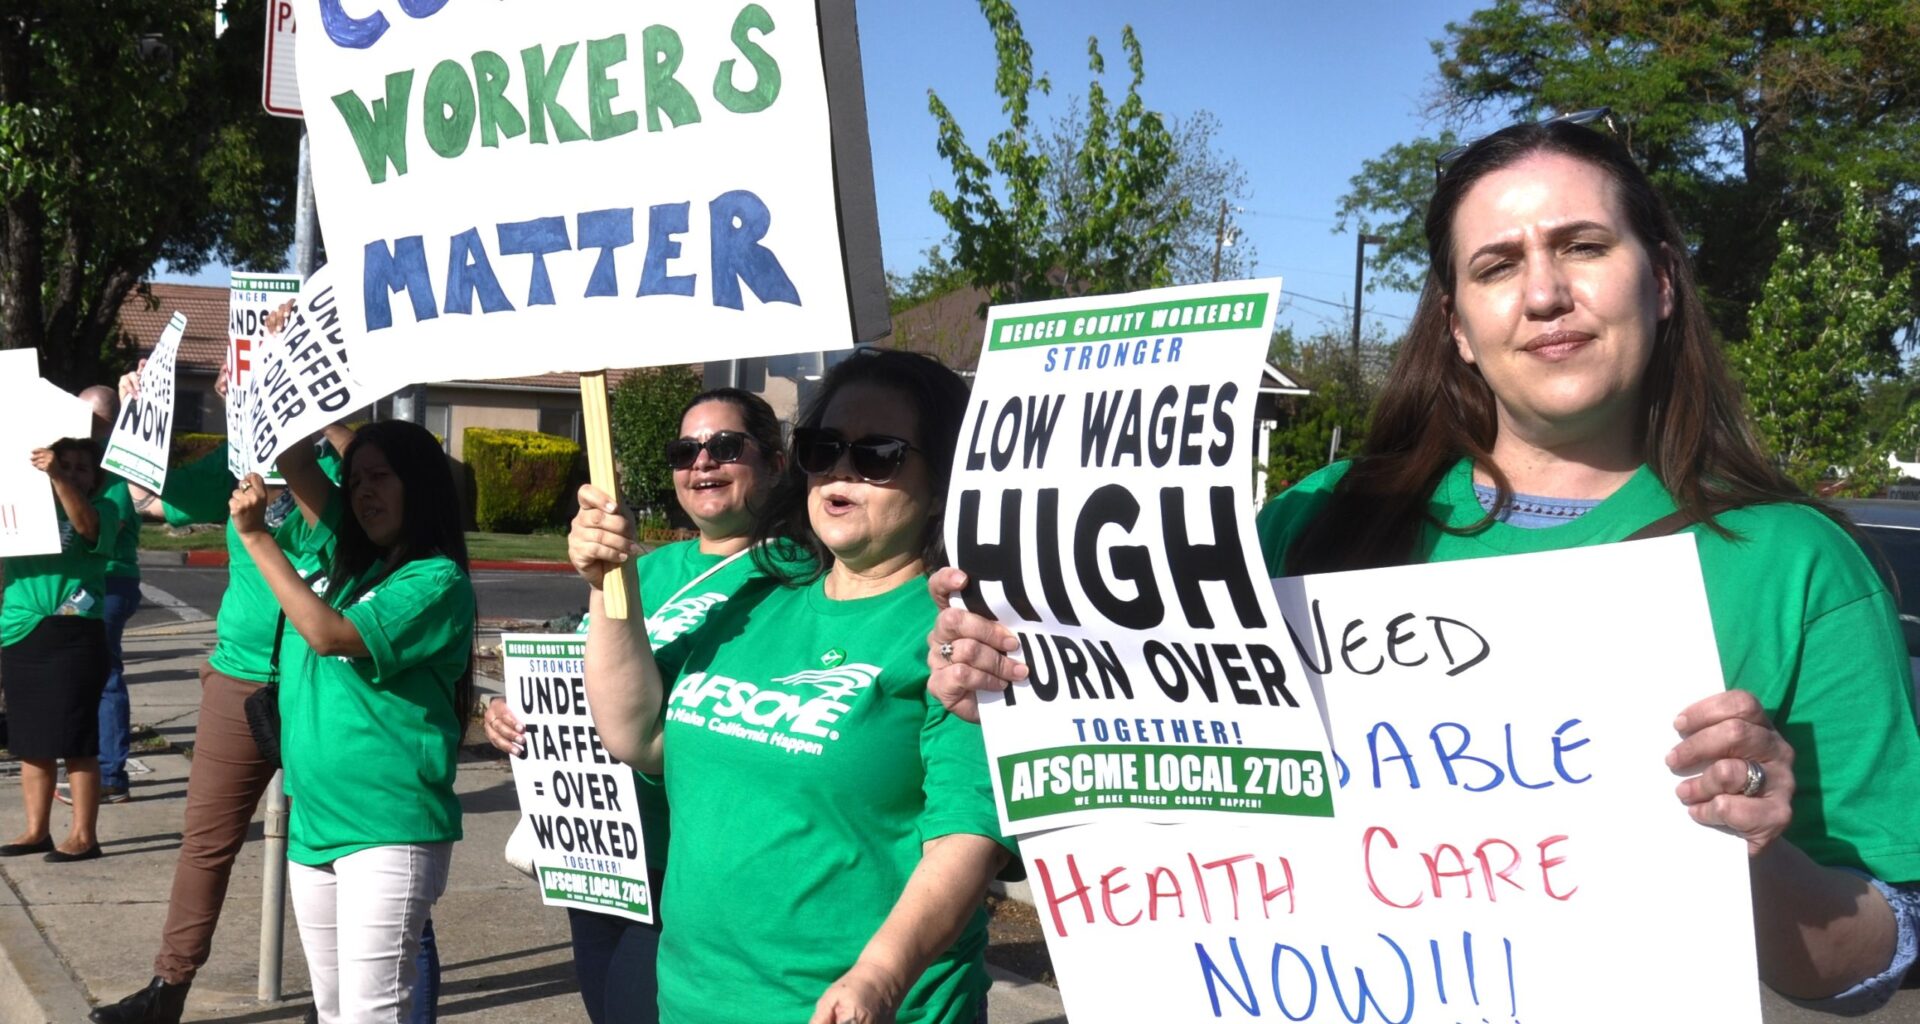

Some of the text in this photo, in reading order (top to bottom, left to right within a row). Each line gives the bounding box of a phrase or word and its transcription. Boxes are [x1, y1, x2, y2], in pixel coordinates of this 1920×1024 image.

[331, 3, 782, 185] WORKERS
[363, 189, 802, 333] MATTER
[1000, 301, 1255, 343] MERCED COUNTY WORKERS!
[1044, 337, 1184, 372] STRONGER
[264, 358, 307, 428] OVER
[120, 397, 169, 450] NOW
[966, 381, 1239, 472] LOW WAGES
[957, 483, 1268, 630] HIGH
[1142, 639, 1300, 708] OVER
[708, 717, 768, 743] California
[769, 731, 823, 756] Happen
[1072, 718, 1243, 745] TOGETHER!
[552, 769, 622, 812] OVER
[1011, 753, 1324, 802] AFSCME LOCAL 2703
[1074, 796, 1089, 806] WE
[1097, 795, 1123, 804] MAKE
[1130, 795, 1168, 805] MERCED
[1174, 796, 1213, 805] COUNTY
[529, 813, 638, 860] WORKED
[544, 870, 588, 895] AFSCME
[589, 875, 621, 900] LOCAL
[622, 881, 647, 905] 2703
[563, 855, 622, 874] TOGETHER!
[1362, 826, 1579, 909] CARE
